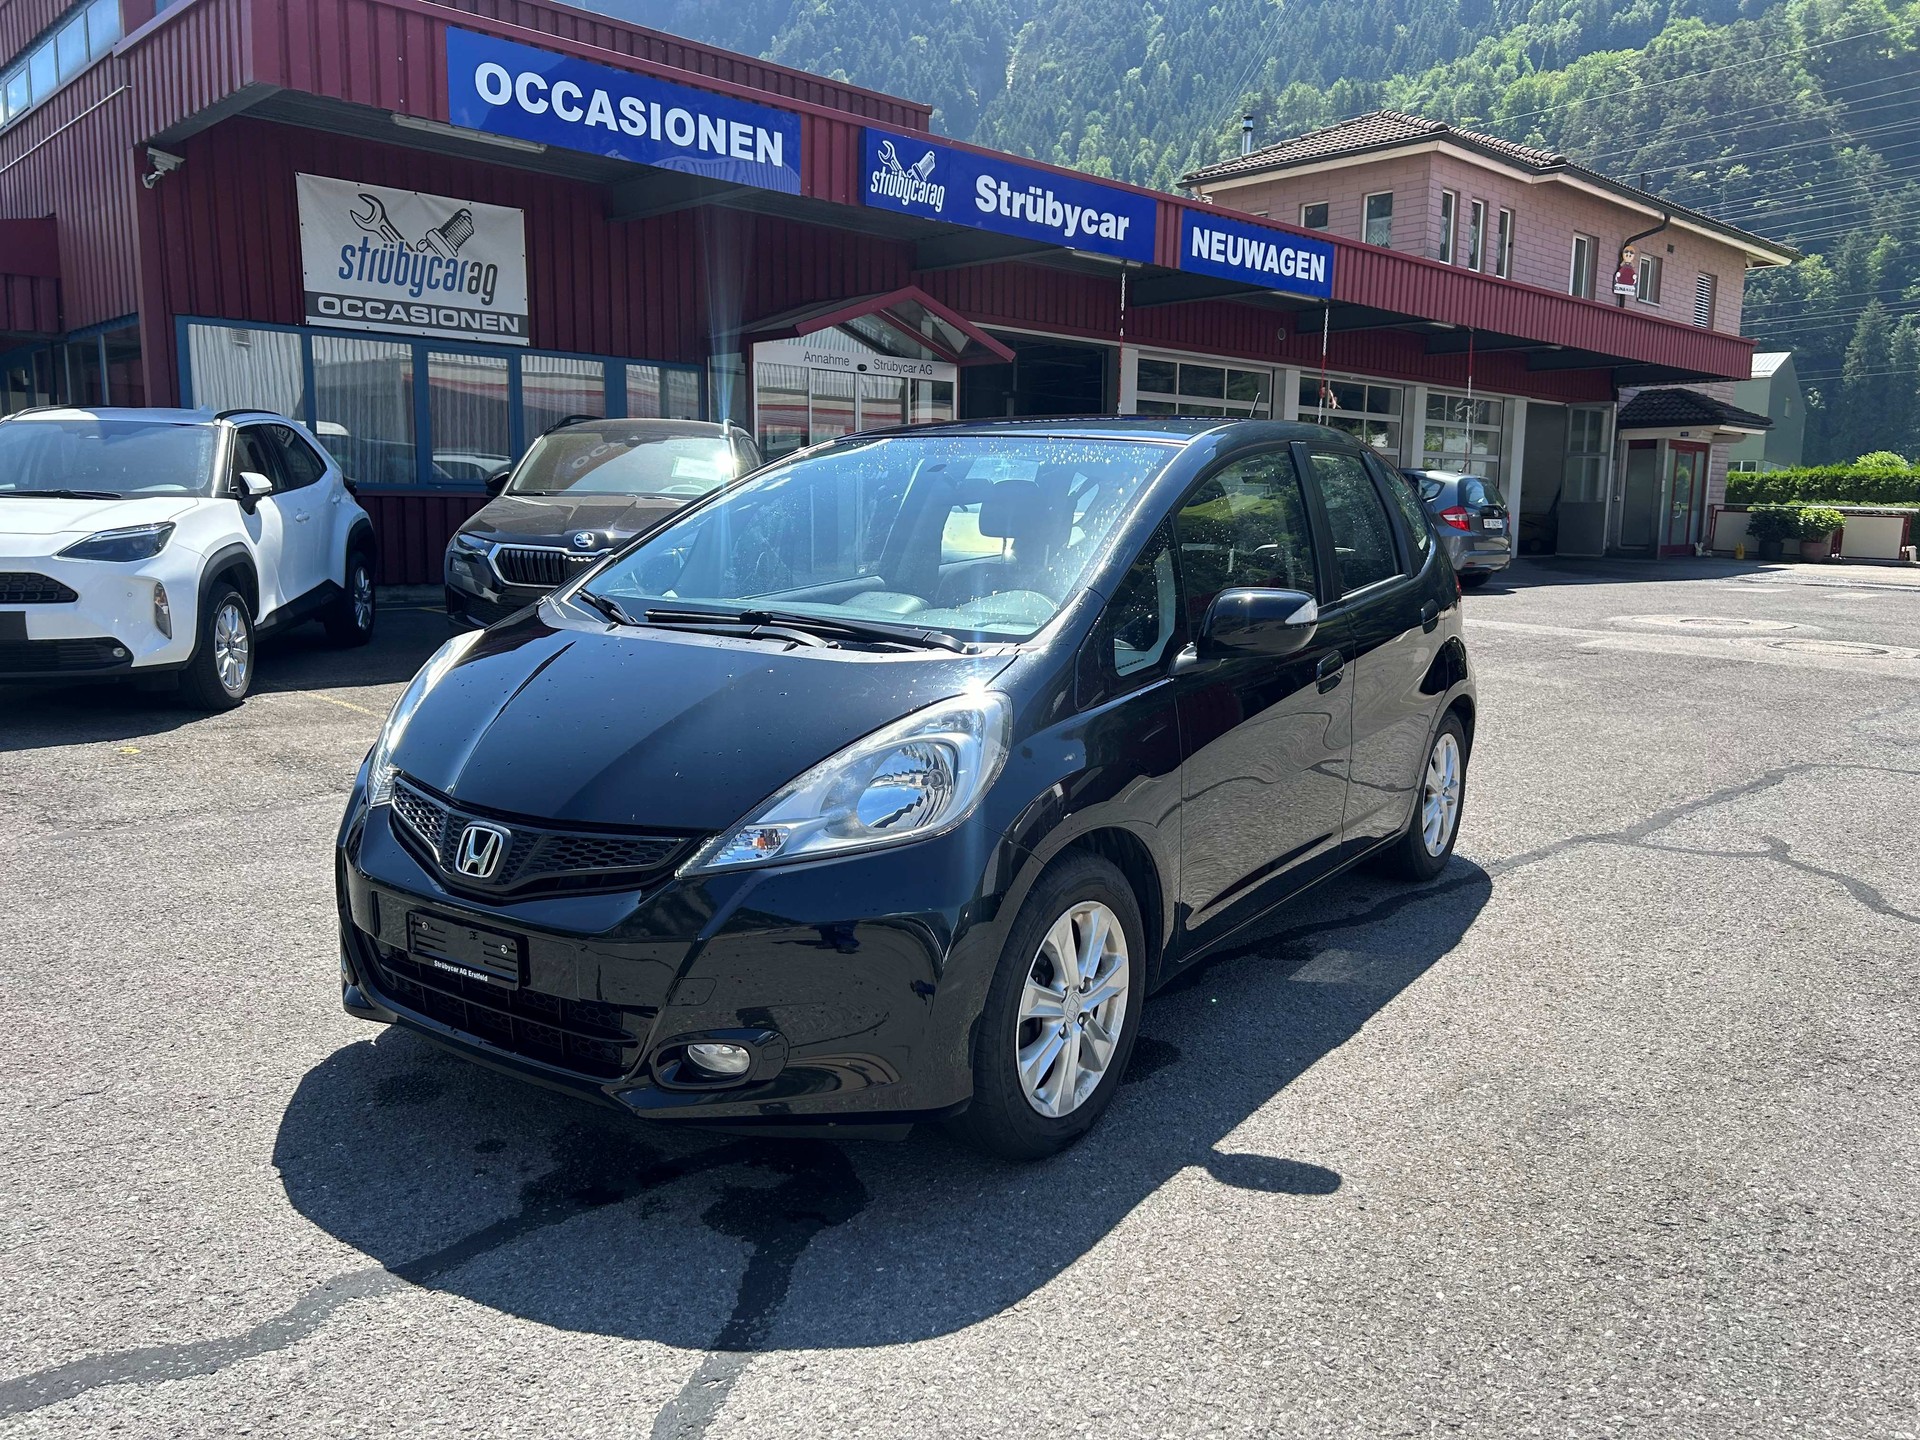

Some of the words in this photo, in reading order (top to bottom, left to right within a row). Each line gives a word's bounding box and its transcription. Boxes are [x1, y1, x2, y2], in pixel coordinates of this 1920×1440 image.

[474, 62, 783, 168] OCCASIONEN
[975, 174, 1130, 241] Strübycar
[1191, 226, 1326, 282] NEUWAGEN
[317, 296, 520, 333] OCCASIONEN
[803, 350, 850, 366] Annahme
[873, 359, 918, 375] Strübycar
[918, 364, 933, 375] AG
[459, 967, 468, 975] AG
